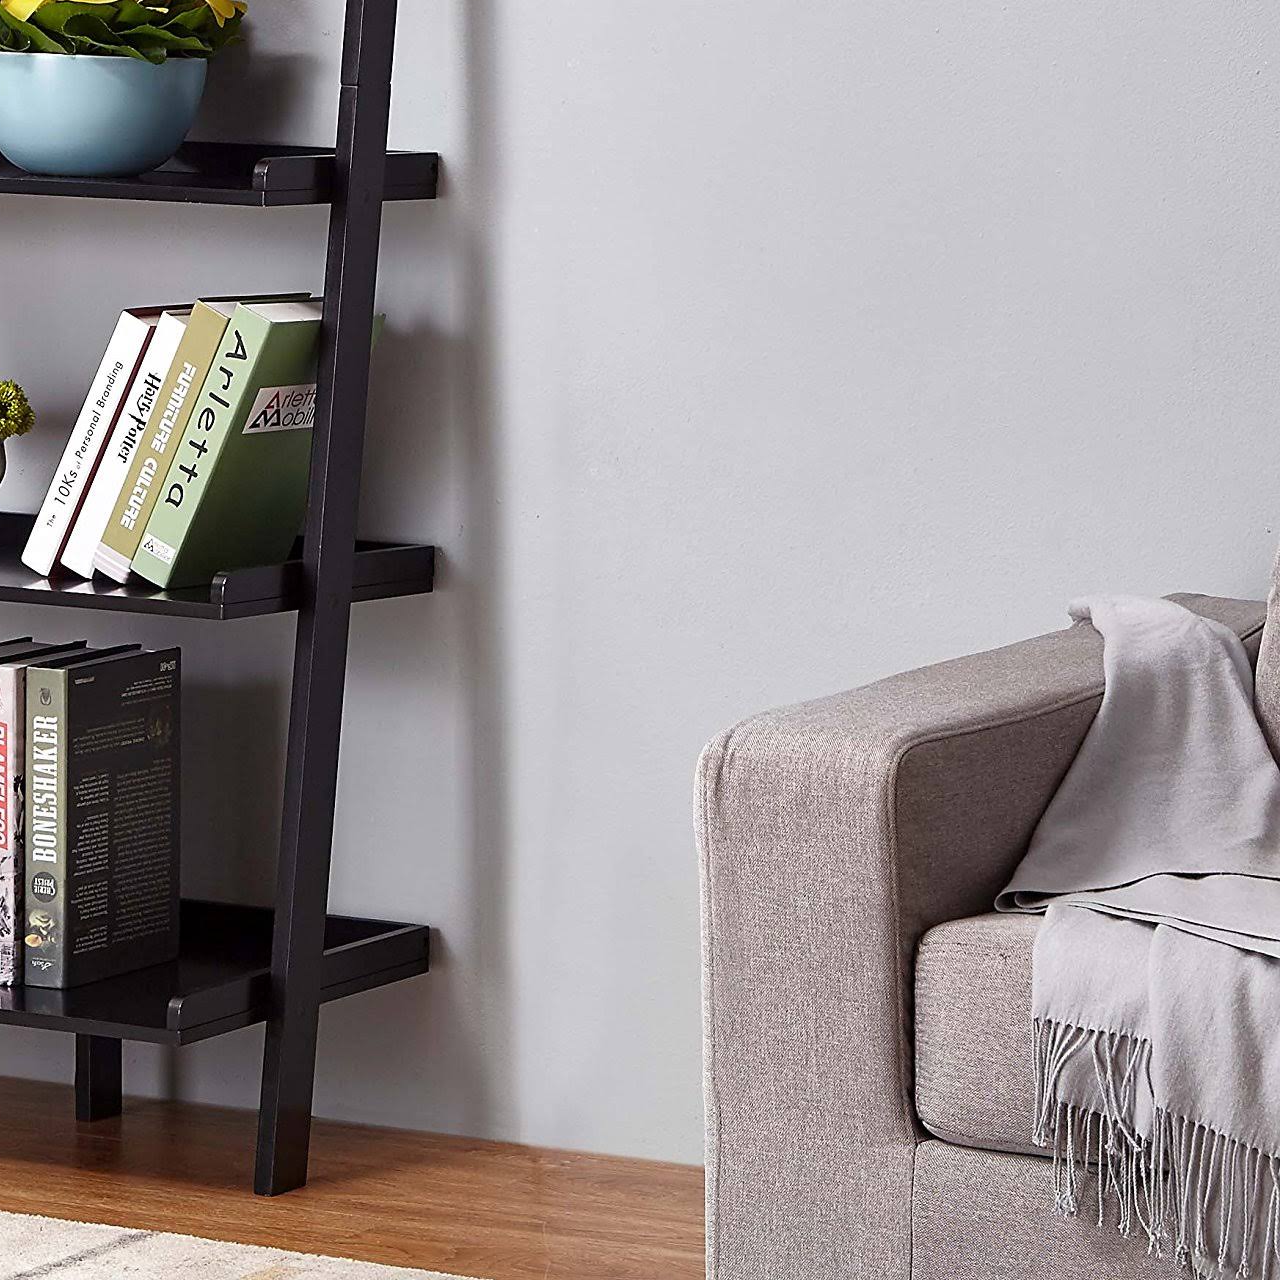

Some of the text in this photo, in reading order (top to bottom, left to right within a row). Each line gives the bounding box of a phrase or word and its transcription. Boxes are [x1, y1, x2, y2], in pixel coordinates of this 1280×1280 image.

[46, 514, 58, 528] The
[53, 469, 78, 506] 10Ks
[75, 409, 101, 460] Personal
[97, 360, 124, 406] Branding
[117, 372, 162, 464] Harry Potter
[165, 329, 248, 508] Arletta
[265, 389, 317, 409] Arlett
[32, 715, 58, 864] BONESHAKER
